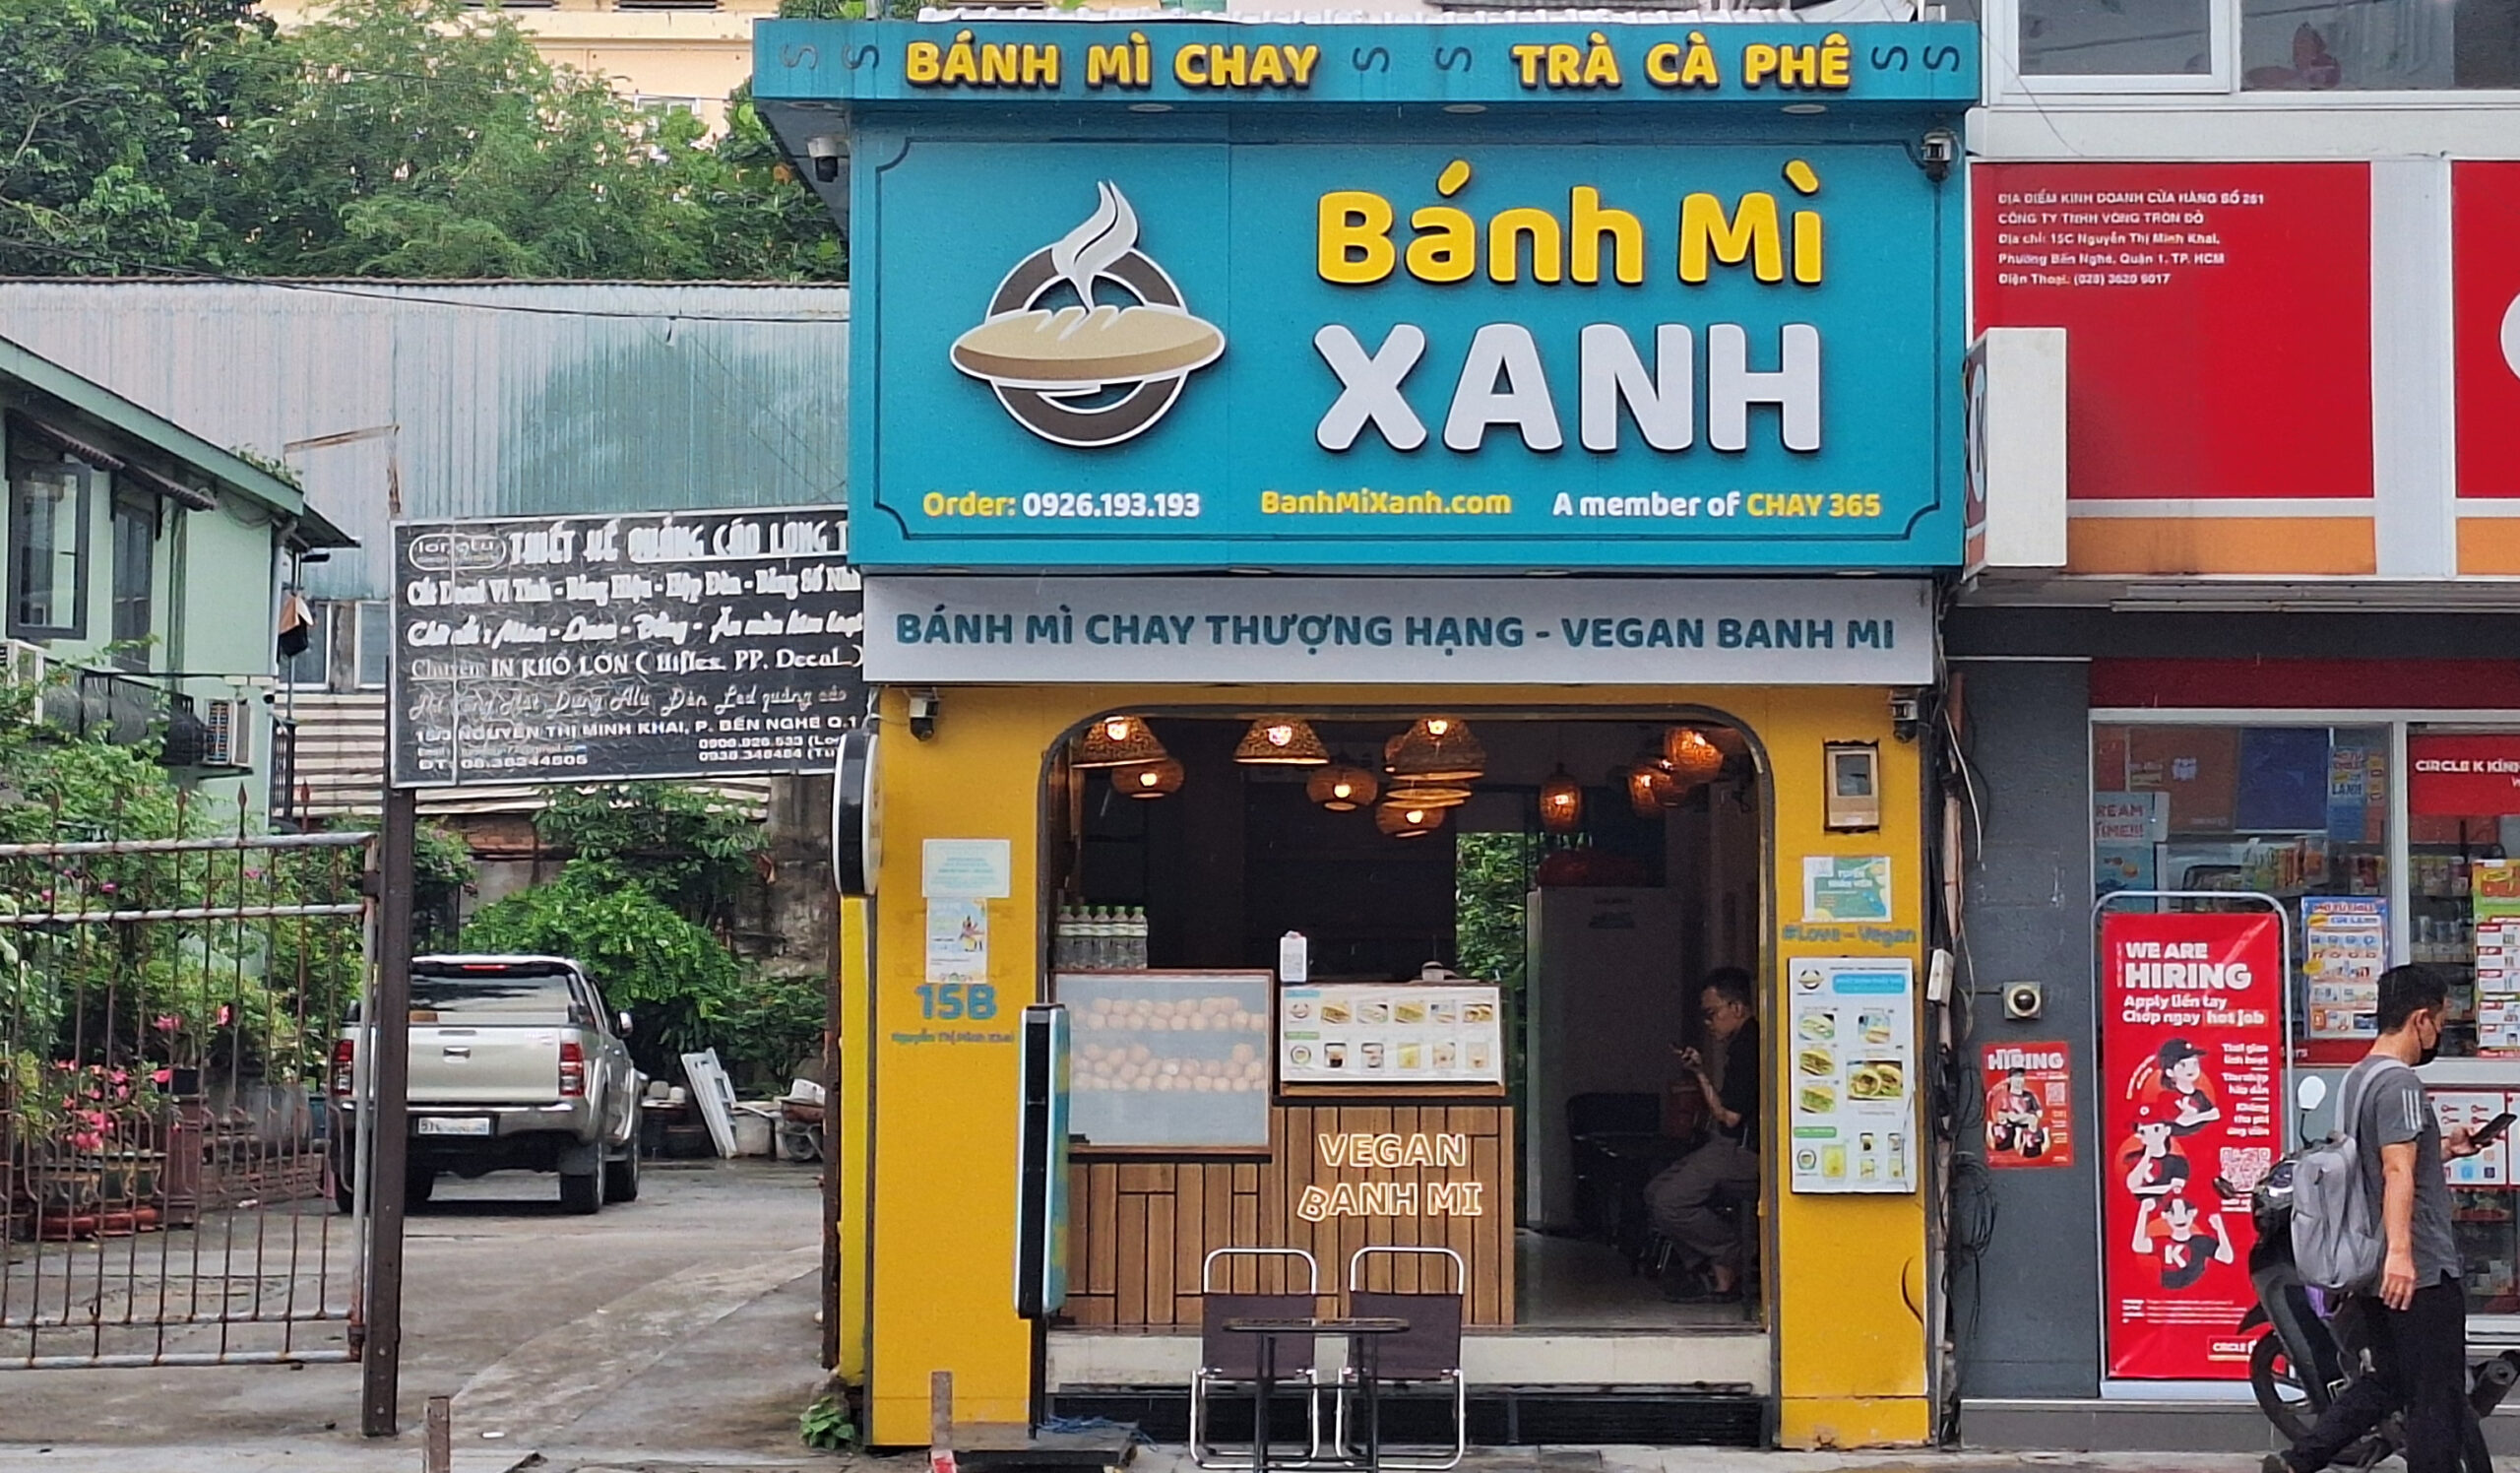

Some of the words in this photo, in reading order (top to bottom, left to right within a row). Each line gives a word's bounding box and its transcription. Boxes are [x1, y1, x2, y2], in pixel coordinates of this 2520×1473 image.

[906, 30, 1061, 88] BÁNH
[1087, 31, 1153, 89] MÌ
[1173, 43, 1321, 89] CHAY
[1511, 32, 1621, 89] TRÀ
[1645, 32, 1719, 89] CÀ
[1744, 32, 1852, 89] PHÊ
[2061, 193, 2093, 204] KINH
[2097, 193, 2143, 204] DOANH
[1316, 159, 1644, 287] Bánh
[1677, 159, 1823, 286] Mì
[1998, 211, 2037, 224] CÔNG
[2042, 213, 2057, 224] TY
[2061, 213, 2098, 224] TNHH
[2051, 233, 2074, 244] 15C
[2078, 230, 2125, 246] Nguyễn
[2129, 232, 2149, 245] Thị
[2153, 232, 2183, 244] Minh
[2194, 253, 2225, 264] HCM
[1312, 322, 1821, 454] XANH
[922, 492, 1016, 518] Order:
[1021, 492, 1201, 519] 0926.193.193
[1260, 488, 1513, 516] BanhMiXanh.com
[1552, 492, 1575, 518] A
[1579, 491, 1702, 518] member
[1706, 490, 1740, 518] of
[1745, 492, 1824, 518] CHAY
[1829, 492, 1882, 518] 365
[770, 520, 827, 553] LONG
[896, 604, 1013, 646] BÁNH
[1025, 604, 1074, 645] MÌ
[1085, 613, 1195, 646] CHAY
[1206, 612, 1394, 657] THƯỢNG
[1405, 616, 1525, 657] HẠNG
[1561, 617, 1704, 650] VEGAN
[1716, 618, 1834, 651] BANH
[1847, 618, 1895, 651] MI
[492, 657, 514, 677] IN
[714, 684, 756, 715] Led
[545, 724, 577, 740] THỊ
[583, 723, 631, 738] MINH
[696, 721, 714, 734] P.
[720, 716, 760, 733] BẾN
[2416, 759, 2470, 772] CIRCLE
[2473, 760, 2486, 773] K
[2125, 942, 2161, 960] WE
[2164, 942, 2208, 960] ARE
[2124, 963, 2252, 991] HIRING
[915, 984, 998, 1020] 15B
[2123, 994, 2169, 1010] Apply
[2202, 994, 2228, 1010] tay
[2163, 1012, 2201, 1027] ngay
[2206, 1011, 2235, 1024] hot
[2236, 1009, 2265, 1027] job
[1987, 1052, 2065, 1071] HIRING
[1318, 1133, 1467, 1169] VEGAN
[1296, 1183, 1418, 1223] BANH
[1426, 1183, 1483, 1217] MI
